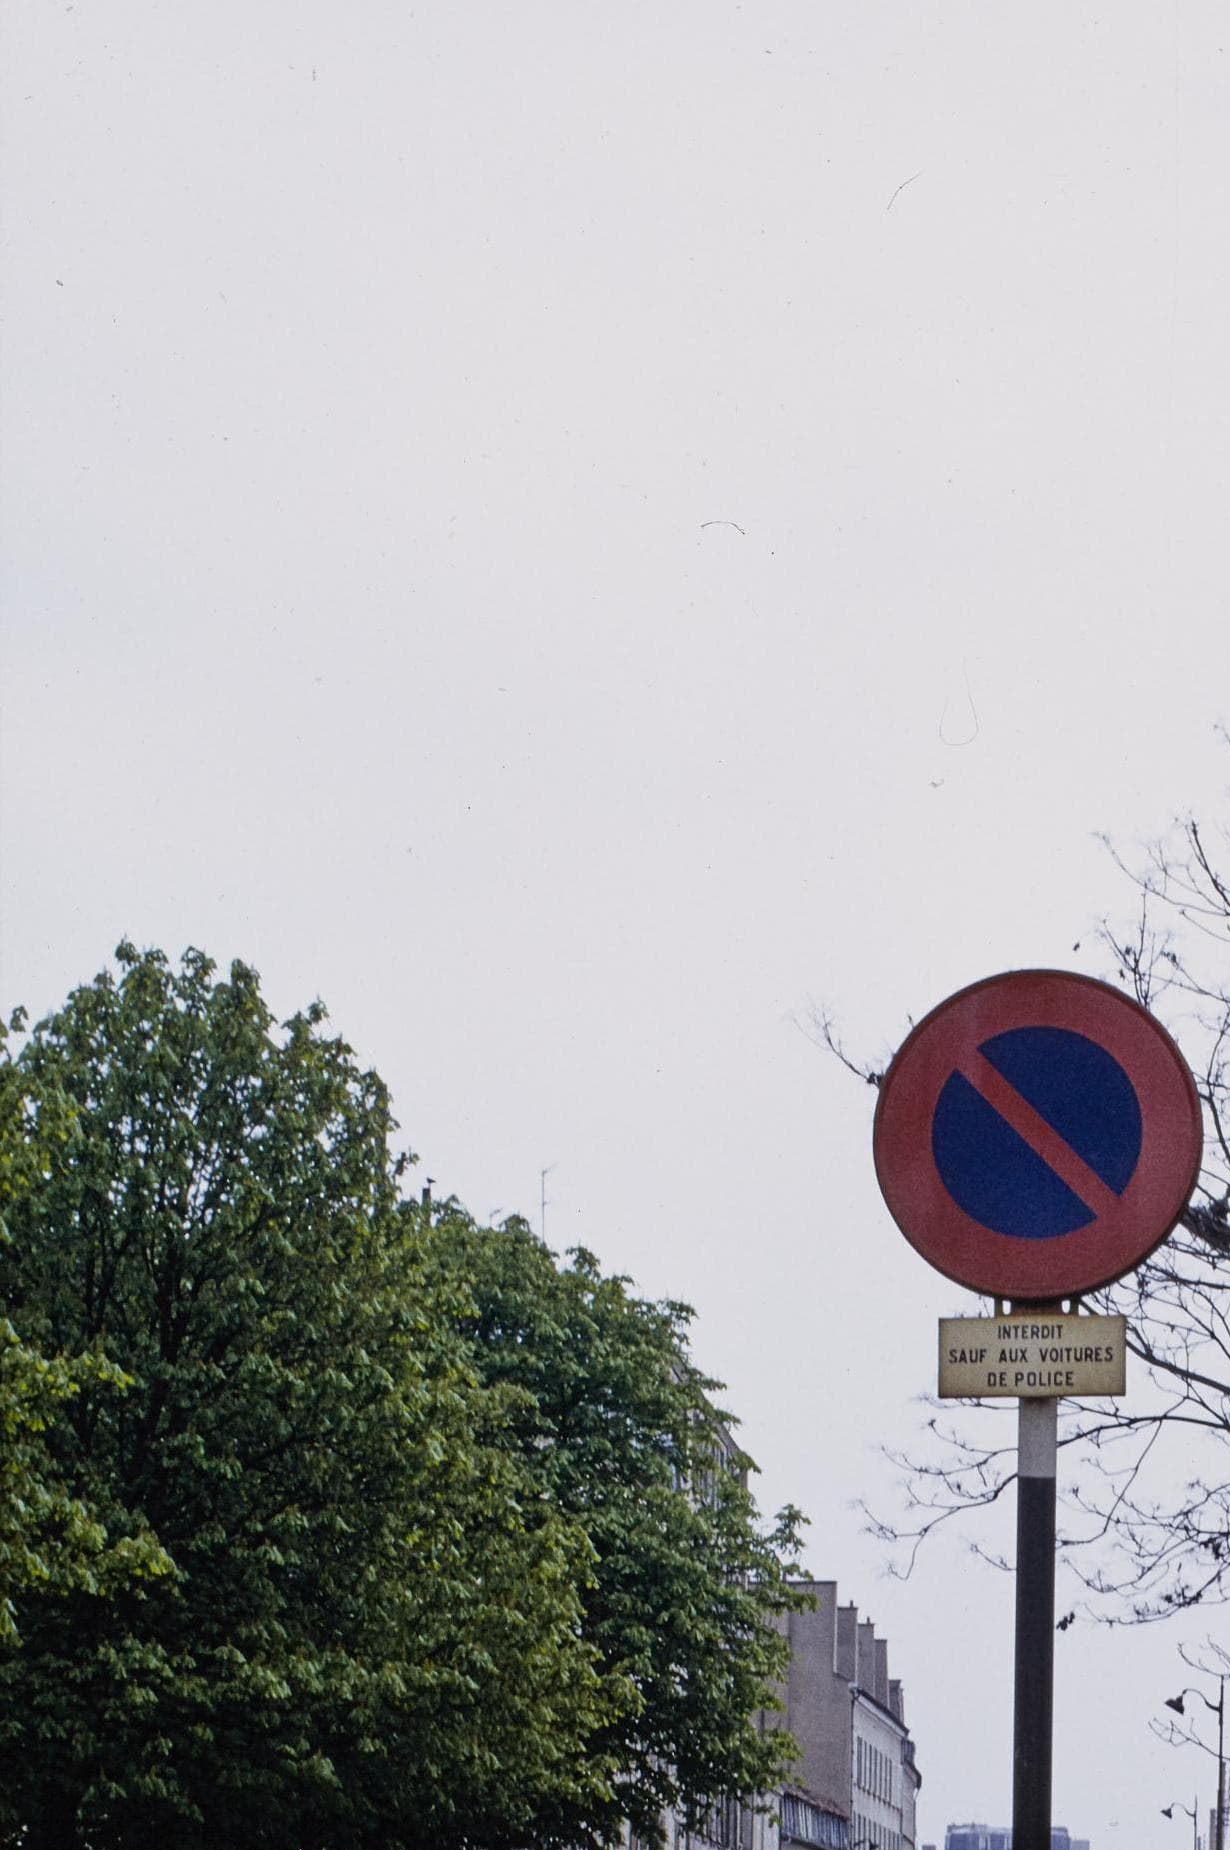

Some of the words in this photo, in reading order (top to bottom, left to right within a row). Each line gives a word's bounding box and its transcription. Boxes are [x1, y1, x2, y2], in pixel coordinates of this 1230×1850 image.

[998, 1325, 1063, 1340] INTERDIT
[949, 1348, 987, 1364] SAUF
[999, 1348, 1028, 1363] AUX
[1039, 1346, 1113, 1363] VOITURES
[987, 1372, 1007, 1387] DE
[1015, 1371, 1074, 1387] POLICE
